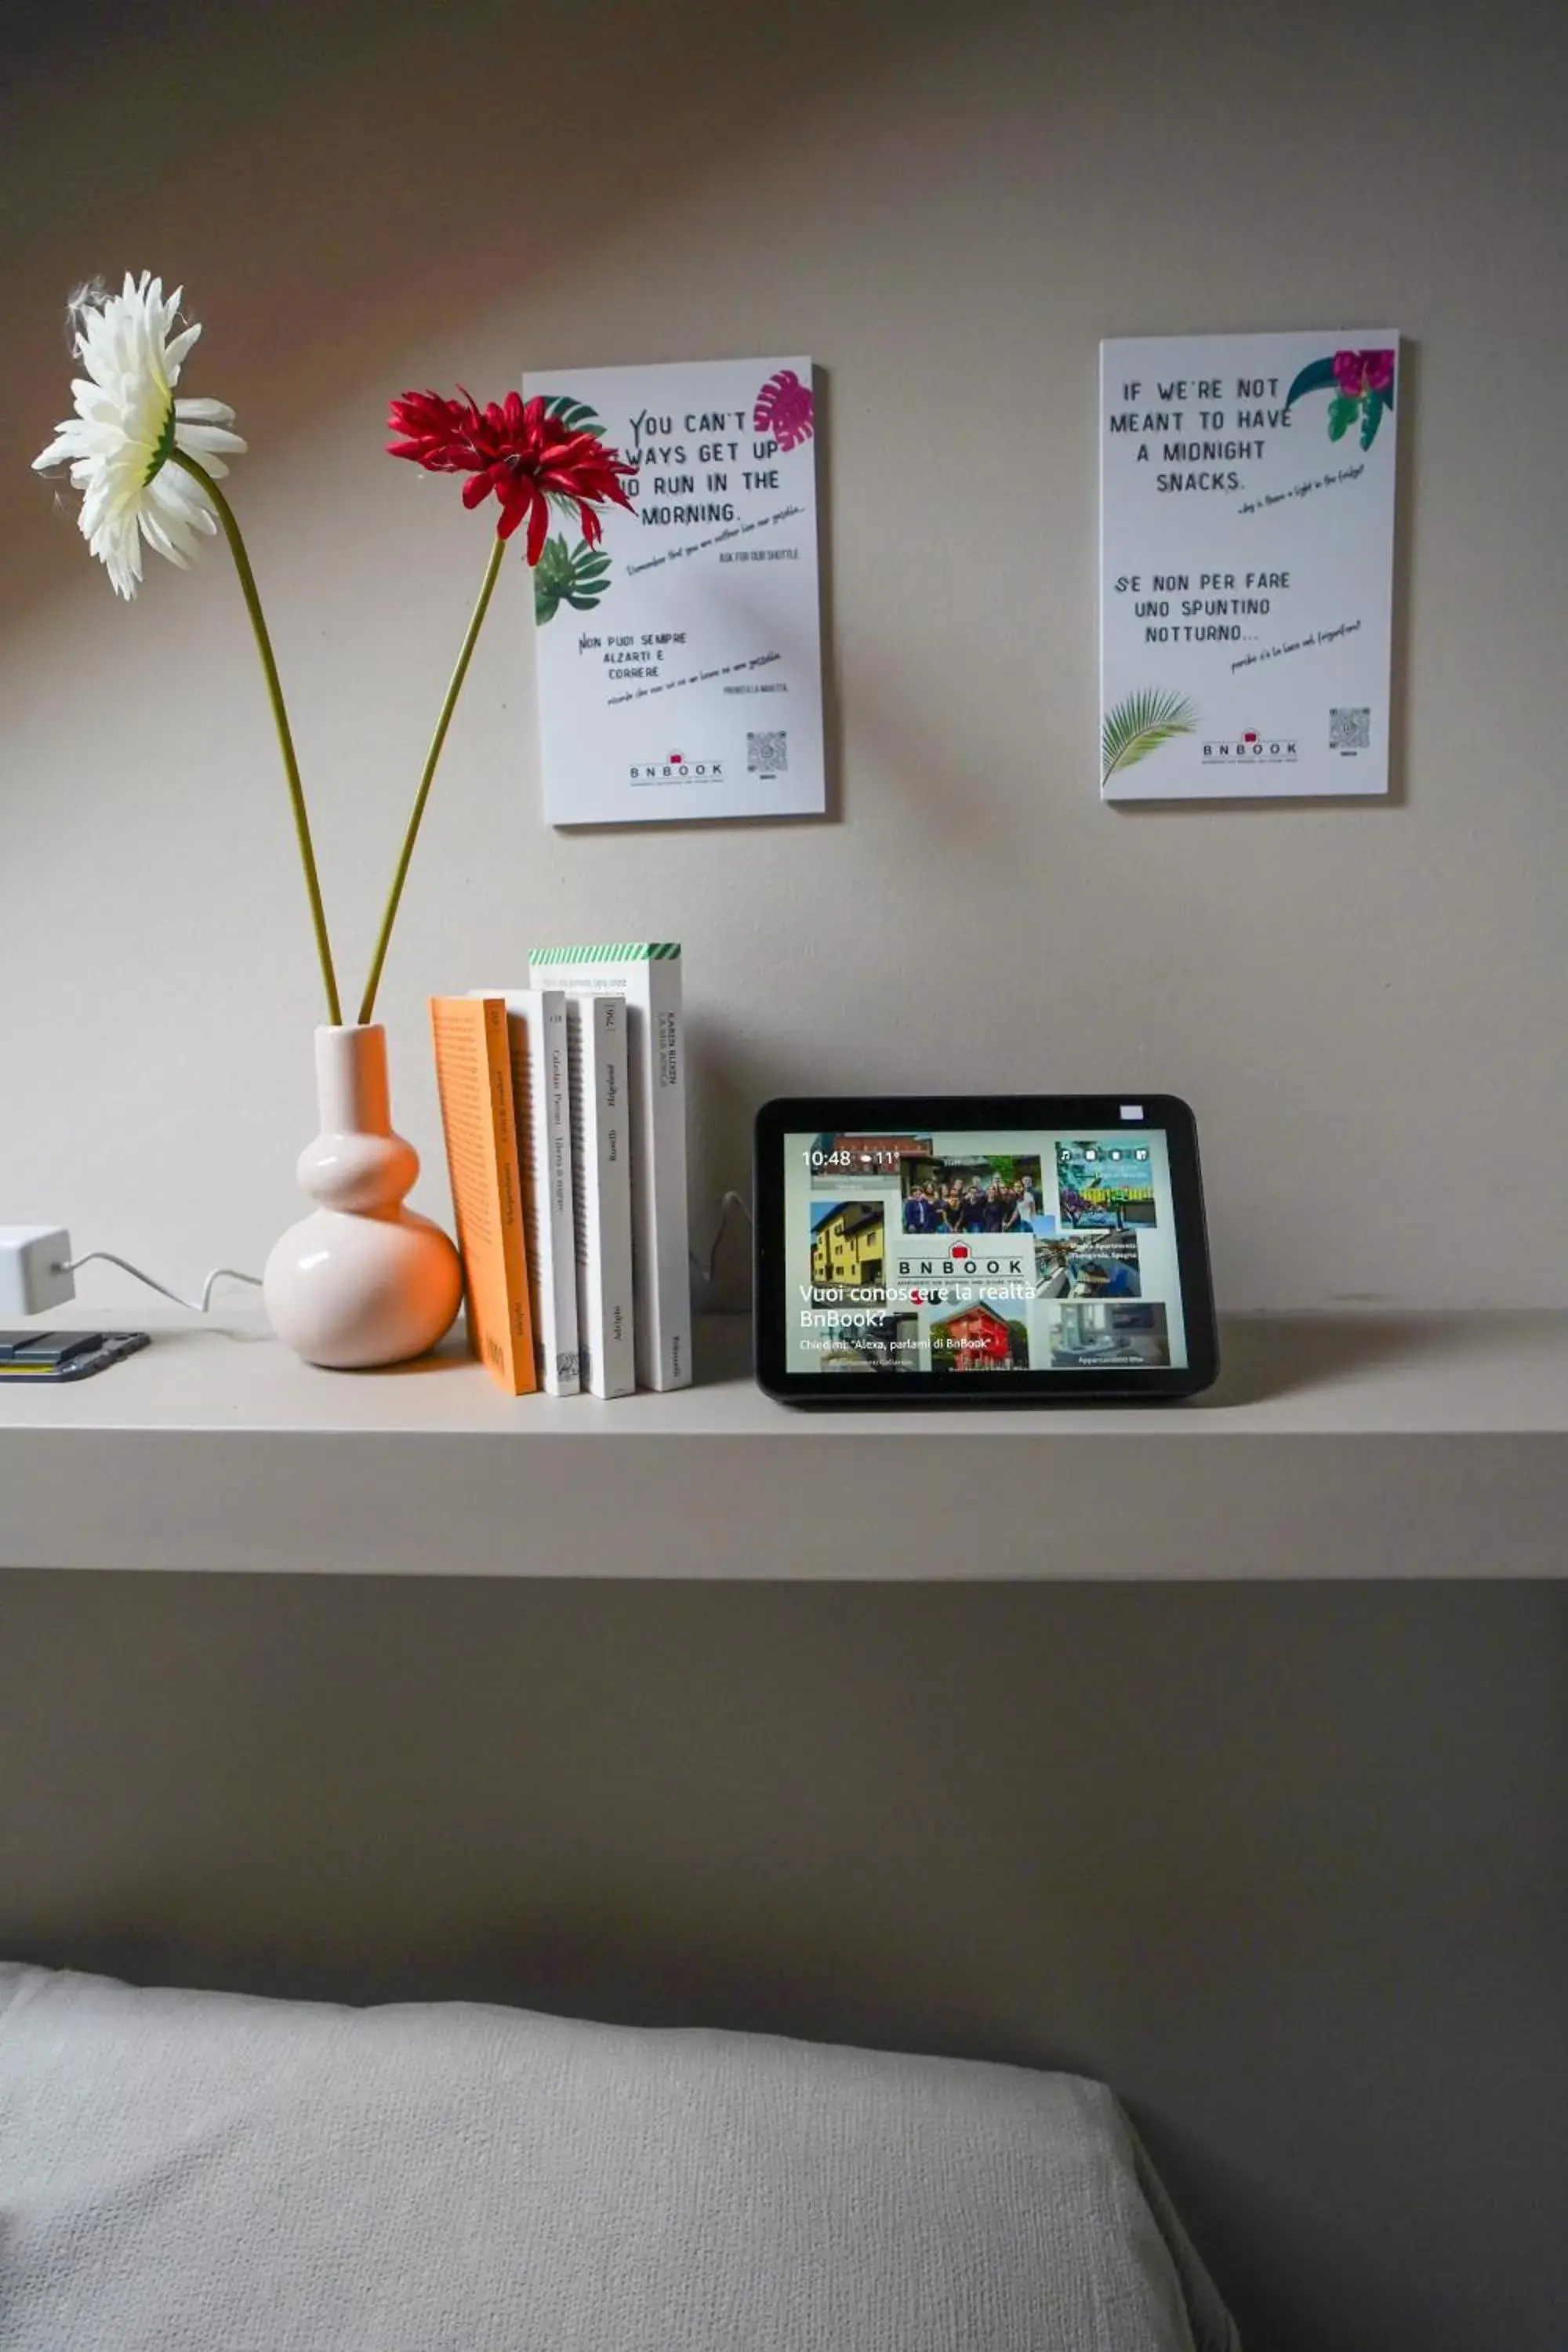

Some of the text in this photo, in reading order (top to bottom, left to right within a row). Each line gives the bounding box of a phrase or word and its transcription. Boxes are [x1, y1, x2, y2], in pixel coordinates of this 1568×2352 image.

[1123, 378, 1279, 401] IF WE'RE NOT
[629, 408, 746, 449] YOU CAN'T
[1110, 408, 1292, 433] MEANT TO HAVE
[616, 438, 779, 468] WAYS GET UP
[1137, 440, 1265, 462] A MIDNIGHT
[654, 474, 694, 495] RUN
[707, 473, 728, 492] IN
[742, 470, 779, 490] THE
[1156, 470, 1246, 492] SNACKS.
[642, 503, 741, 525] MORNING.
[1114, 572, 1290, 593] SE NON PER FARE
[1134, 598, 1270, 618] UNO SPUNTINO
[579, 633, 602, 655] NON
[603, 649, 664, 664] ALZARTI E
[1203, 743, 1298, 756] BNBOOK
[629, 764, 724, 780] BNBOOK
[802, 1151, 901, 1167] 10:48 11°
[899, 1260, 1022, 1274] BNBOOK
[800, 1281, 1036, 1302] Vuoi conoscere la realtà
[800, 1308, 886, 1328] BnBook?
[889, 1338, 931, 1352] parlami
[933, 1337, 945, 1349] di
